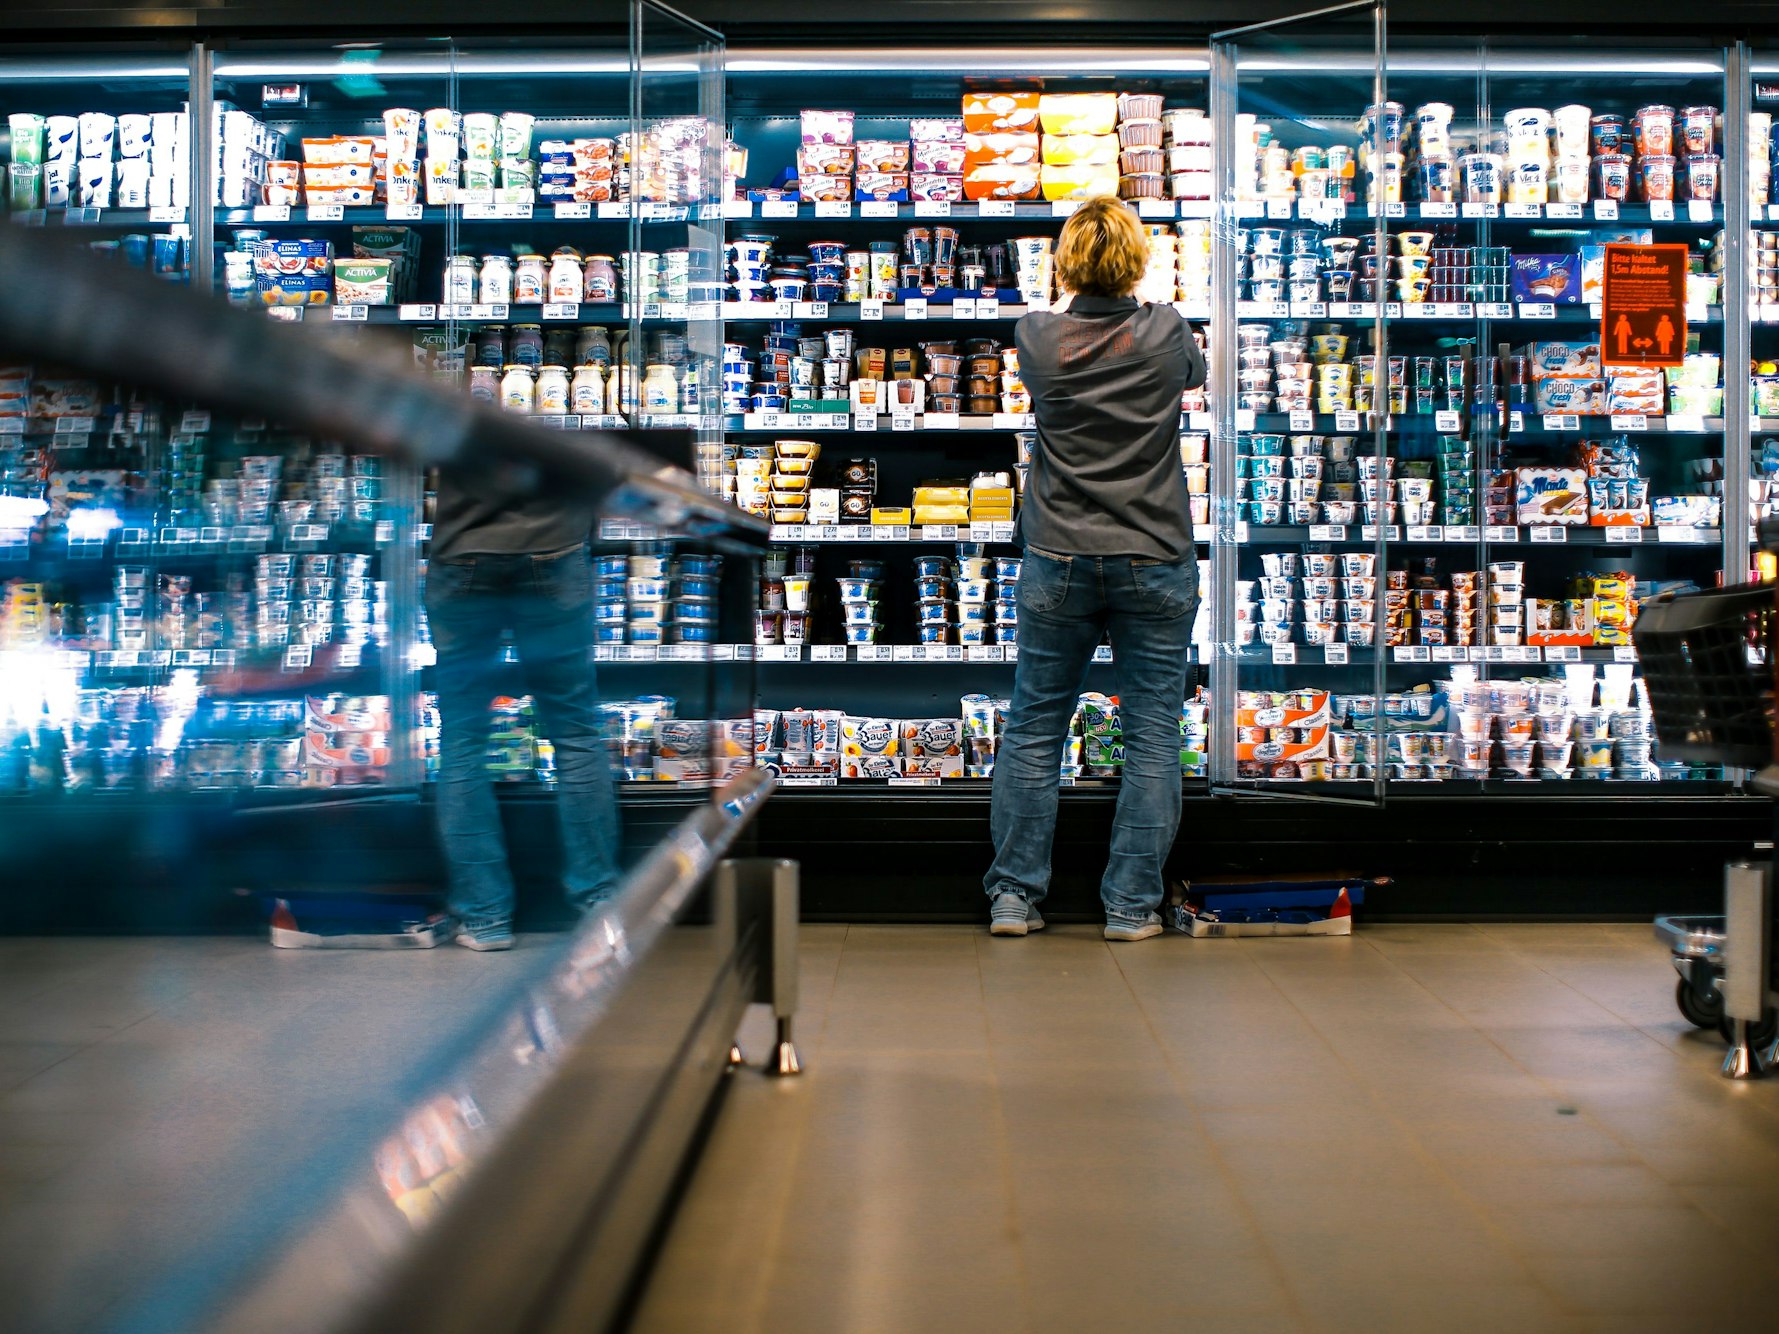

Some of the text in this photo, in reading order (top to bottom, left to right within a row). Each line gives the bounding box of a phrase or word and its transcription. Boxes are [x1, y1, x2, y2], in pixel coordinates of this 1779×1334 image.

[362, 235, 394, 243] ACTIVIA
[1515, 257, 1541, 270] Milka
[1611, 253, 1657, 264] Bitte haltet
[345, 267, 378, 277] ACTIVIA
[1610, 264, 1669, 275] 1,5m Abstand!
[421, 336, 458, 344] ACTIVA
[1541, 346, 1570, 357] CHOCO
[1545, 356, 1566, 366] fresh
[1546, 383, 1575, 394] CHOCO
[1549, 393, 1572, 402] fresh
[1532, 476, 1569, 495] Monte
[1304, 712, 1326, 726] Classic
[859, 730, 893, 743] Bauer
[923, 731, 957, 743] Bauer
[1302, 745, 1324, 759] Classic
